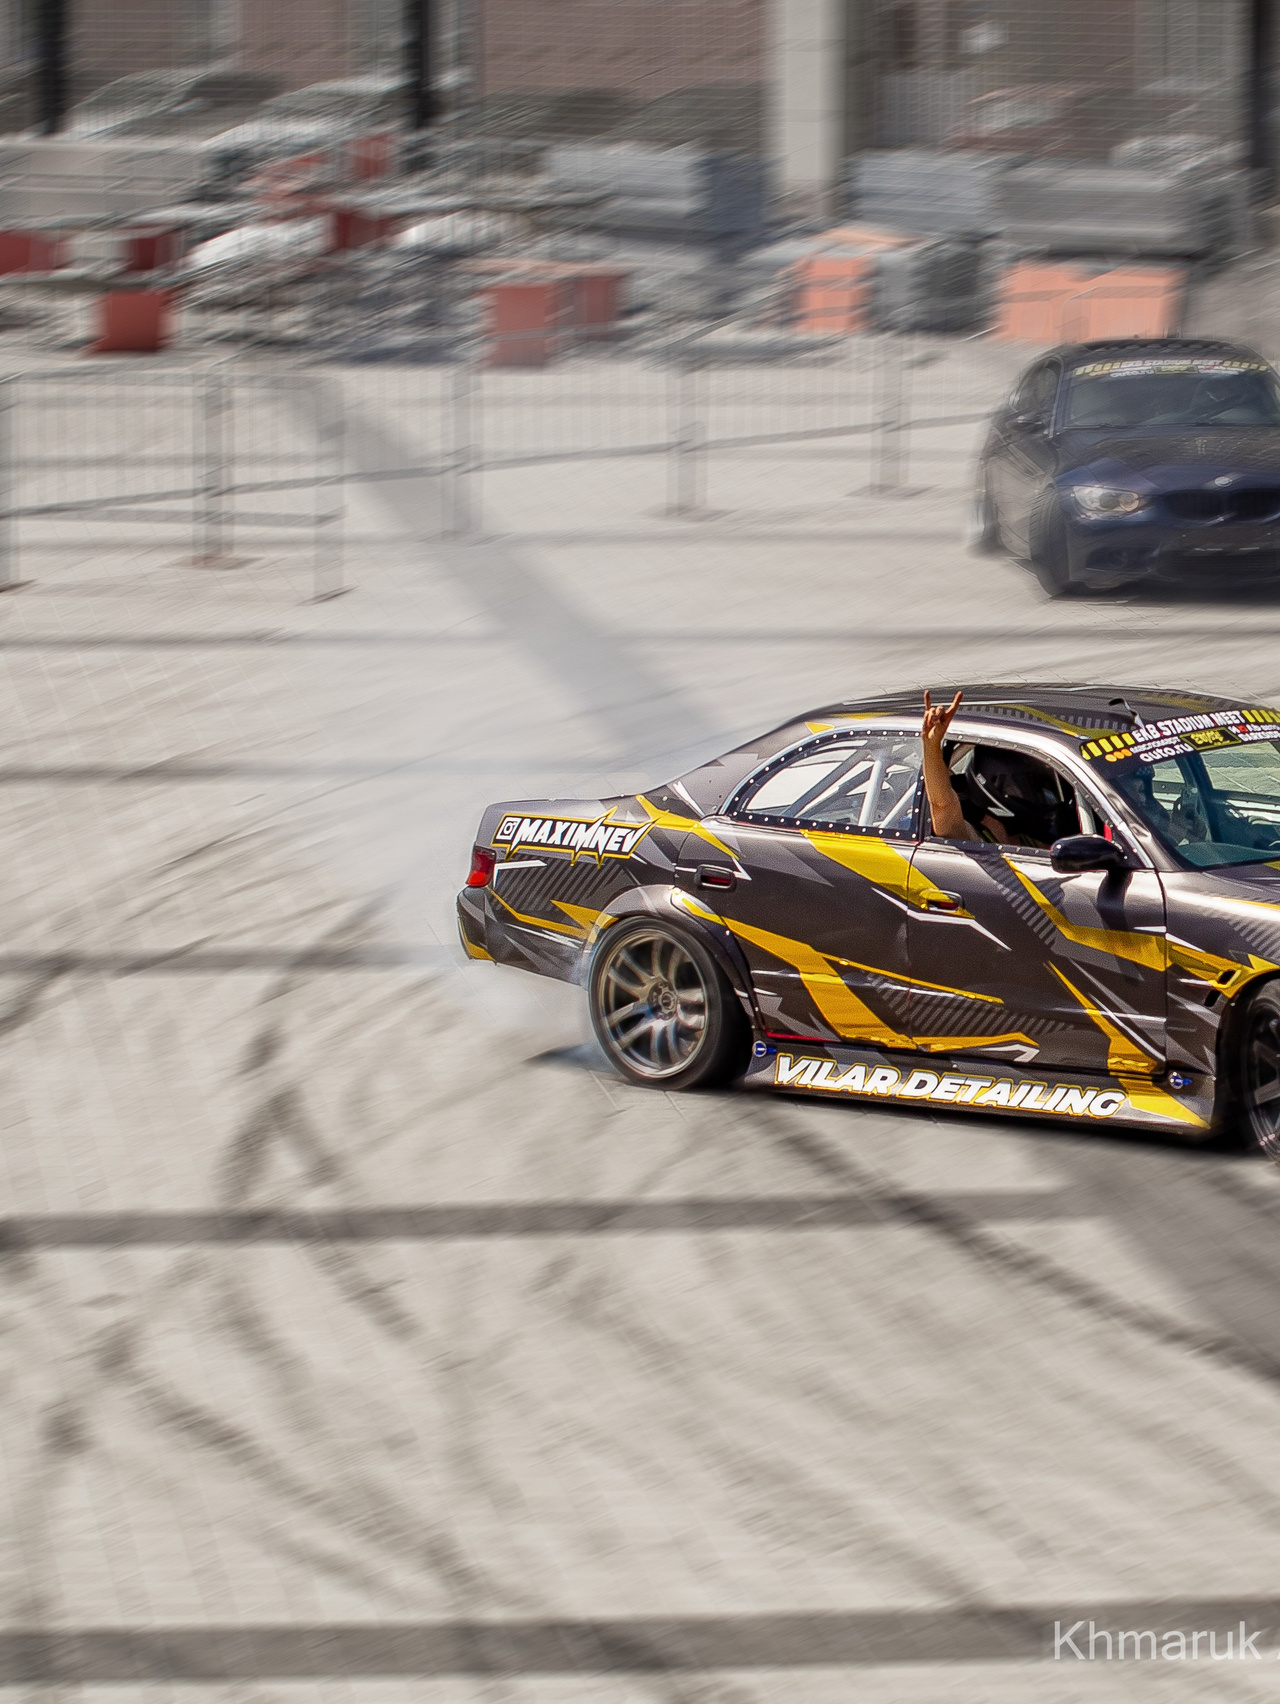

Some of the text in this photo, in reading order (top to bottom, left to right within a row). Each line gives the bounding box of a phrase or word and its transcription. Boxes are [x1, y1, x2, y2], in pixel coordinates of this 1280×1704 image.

[1132, 723, 1162, 743] EKB
[1157, 713, 1216, 736] STADIUM
[1210, 710, 1246, 728] MEET
[1139, 742, 1195, 762] auto.ru
[776, 1054, 1127, 1118] VILAR DETAILING
